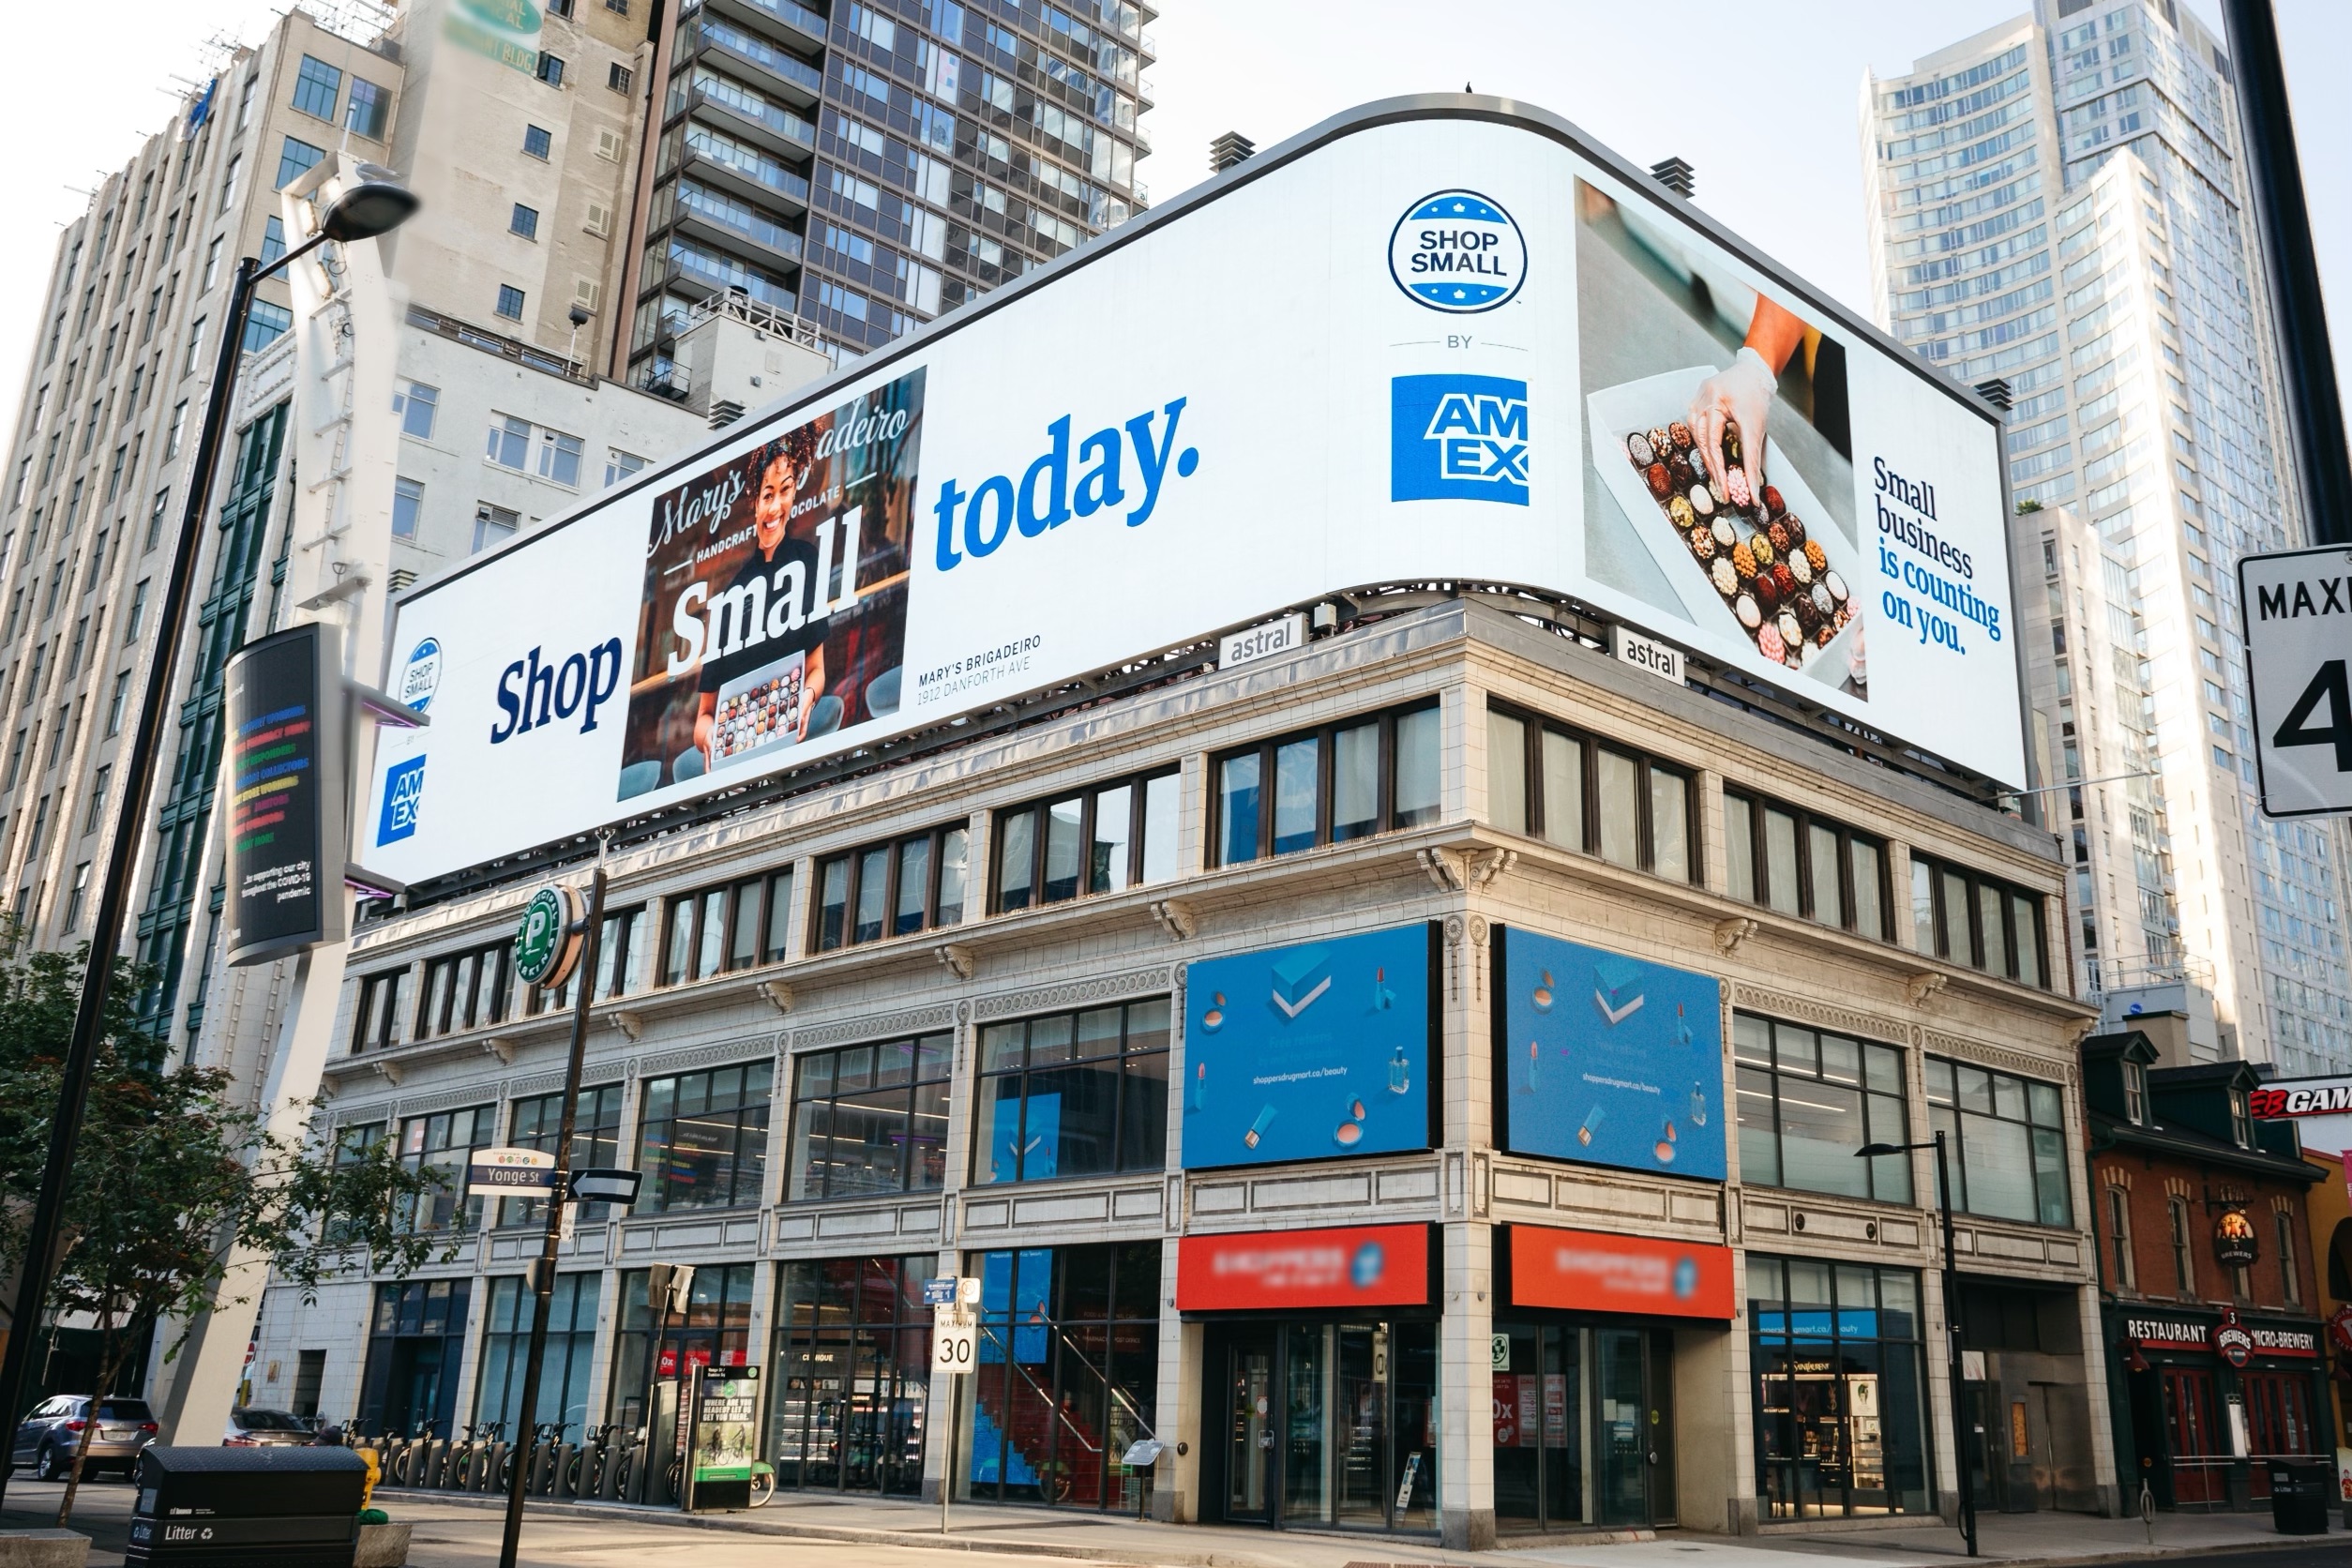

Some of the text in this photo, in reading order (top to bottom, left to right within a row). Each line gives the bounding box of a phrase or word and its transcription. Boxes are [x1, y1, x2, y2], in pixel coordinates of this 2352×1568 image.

[502, 42, 533, 72] BLDG
[1420, 230, 1499, 251] SHOP
[1410, 252, 1508, 277] SMALL
[1447, 335, 1472, 349] BY
[933, 396, 1199, 571] today.
[1874, 456, 1937, 521] Small
[646, 469, 746, 558] Mary's
[696, 484, 840, 565] HANDCRAFT OCOLATE
[1874, 493, 1973, 580] business
[666, 504, 866, 677] Small
[1878, 536, 2001, 641] is counting
[1882, 591, 1966, 656] on you.
[1230, 620, 1291, 662] astral
[918, 634, 1041, 687] MARY'S BRIGADEIRO
[1626, 638, 1676, 677] astral
[409, 662, 434, 683] SHOP
[917, 656, 1031, 706] 1912 DANFORTH AVE
[404, 676, 433, 699] SMALL
[490, 637, 622, 745] Shop
[296, 860, 311, 871] city
[278, 872, 311, 887] COVID-19
[277, 885, 311, 903] pandemic
[488, 1168, 539, 1184] Yonge St
[2229, 1312, 2236, 1324] 3
[2128, 1319, 2206, 1343] RESTAURANT
[2219, 1329, 2252, 1349] BREWERS
[940, 1338, 970, 1363] 30
[1493, 1399, 1513, 1419] 0x
[165, 1525, 197, 1540] Litter
